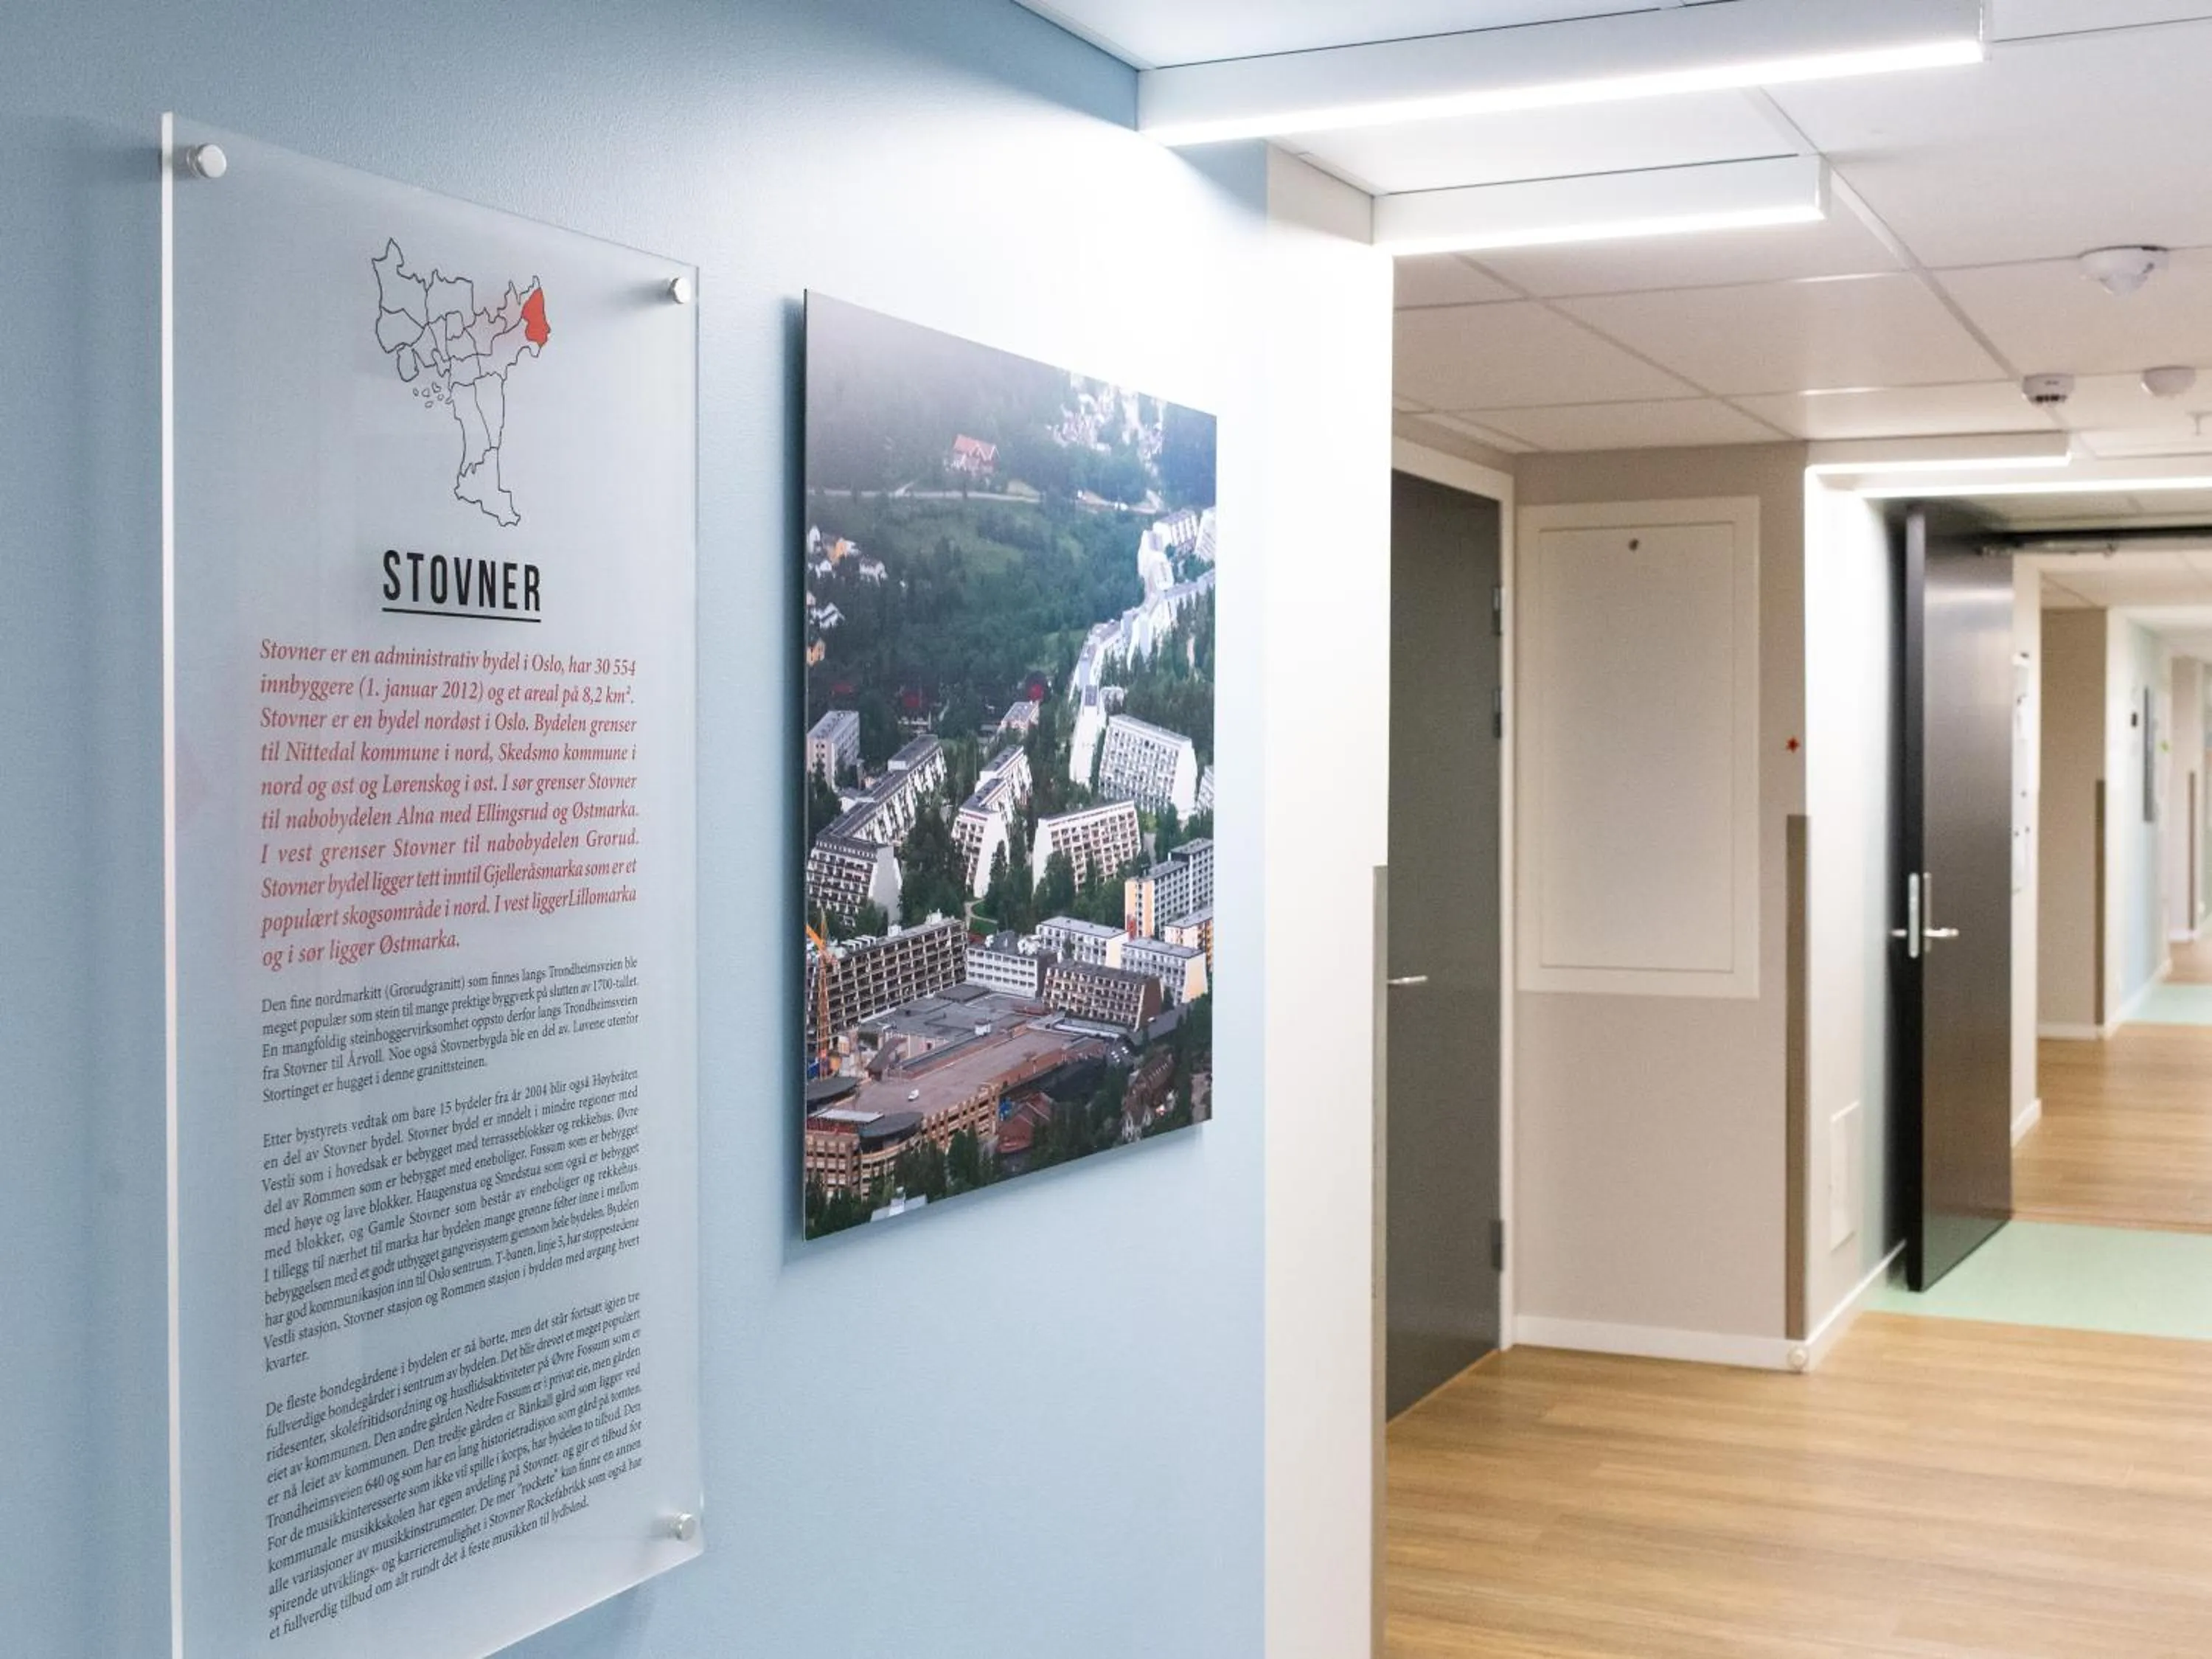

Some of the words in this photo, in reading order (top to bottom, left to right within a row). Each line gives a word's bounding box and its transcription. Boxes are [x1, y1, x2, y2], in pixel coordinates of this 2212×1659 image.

[382, 549, 541, 612] STOVNER
[259, 638, 326, 661] Stovner
[330, 648, 347, 662] er
[349, 649, 370, 664] en
[373, 644, 479, 669] administrativ
[481, 649, 521, 675] bydel
[530, 653, 564, 675] Oslo,
[568, 654, 592, 673] har
[260, 672, 354, 702] innbyggere
[383, 677, 438, 703] januar
[440, 679, 484, 703] 2012)
[487, 686, 505, 706] og
[507, 684, 521, 700] et
[524, 683, 560, 702] areal
[560, 684, 579, 708] på
[581, 685, 602, 706] 8,2
[259, 706, 327, 728] Stovner
[330, 714, 349, 728] er
[352, 714, 372, 729] en
[377, 708, 420, 735] bydel
[423, 709, 481, 731] nordøst
[494, 711, 529, 731] Oslo.
[532, 712, 586, 737] Bydelen
[588, 719, 636, 738] grenser
[260, 740, 280, 761] til
[284, 740, 356, 762] Nittedal
[360, 740, 439, 762] kommune
[454, 740, 493, 765] nord,
[497, 741, 560, 762] Skedsmo
[562, 742, 628, 761] kommune
[260, 773, 303, 796] nord
[306, 780, 327, 801] og
[330, 776, 355, 795] øst
[358, 779, 378, 800] og
[381, 772, 461, 799] Lørenskog
[472, 774, 497, 792] øst.
[510, 777, 533, 791] sør
[534, 776, 585, 796] grenser
[587, 771, 637, 790] Stovner
[261, 807, 280, 830] til
[285, 804, 392, 834] nabobydelen
[396, 804, 434, 825] Alna
[439, 802, 472, 824] med
[475, 801, 549, 827] Ellingsrud
[552, 804, 569, 826] og
[571, 798, 639, 820] Østmarka.
[278, 844, 313, 863] vest
[319, 844, 386, 868] grenser
[392, 837, 456, 858] Stovner
[462, 832, 480, 854] til
[486, 829, 579, 857] nabobydelen
[585, 827, 640, 847] Grorud.
[260, 877, 325, 899] Stovner
[327, 870, 370, 900] bydel
[371, 870, 414, 897] ligger
[415, 869, 440, 888] tett
[442, 863, 482, 886] inntil
[482, 858, 583, 888] Gjelleråsmarka
[584, 861, 610, 877] som
[611, 861, 624, 875] er
[625, 858, 637, 874] et
[260, 907, 339, 939] populært
[341, 897, 442, 930] skogsområde
[453, 894, 490, 917] nord.
[504, 894, 529, 912] vest
[531, 890, 568, 915] ligger
[262, 950, 283, 972] og
[297, 945, 325, 963] sør
[329, 938, 375, 965] ligger
[378, 928, 459, 955] Østmarka.
[261, 998, 287, 1013] Den
[289, 993, 312, 1009] fine
[467, 976, 488, 988] som
[490, 970, 520, 986] finnes
[521, 967, 546, 984] langs
[262, 1018, 299, 1037] meget
[299, 1012, 347, 1034] populær
[349, 1010, 373, 1025] som
[374, 1004, 400, 1024] stein
[401, 1001, 414, 1018] til
[414, 1001, 449, 1017] mange
[262, 1064, 279, 1080] fra
[282, 1057, 327, 1078] Stovner
[330, 1053, 344, 1070] til
[262, 1082, 319, 1103] Stortinget
[321, 1081, 333, 1093] er
[335, 1072, 373, 1093] hugget
[381, 1067, 415, 1083] denne
[262, 1132, 292, 1148] Etter
[295, 1121, 347, 1144] bystyrets
[351, 1110, 388, 1130] vedtak
[391, 1111, 409, 1124] om
[411, 1105, 436, 1120] bare
[439, 1100, 452, 1116] 15
[262, 1158, 279, 1170] en
[282, 1148, 302, 1166] del
[304, 1149, 319, 1162] av
[322, 1139, 369, 1159] Stovner
[407, 1121, 449, 1142] Stovner
[451, 1114, 479, 1136] bydel
[264, 1239, 292, 1260] med
[348, 1225, 366, 1242] og
[365, 1211, 405, 1235] Gamle
[408, 1203, 450, 1227] Stovner
[454, 1200, 477, 1214] som
[265, 1401, 283, 1417] De
[286, 1391, 316, 1411] fleste
[319, 1366, 398, 1402] bondegårdene
[407, 1350, 448, 1374] bydelen
[266, 1492, 281, 1506] er
[282, 1482, 297, 1500] nå
[300, 1474, 325, 1495] leiet
[327, 1470, 341, 1484] av
[267, 1535, 338, 1573] kommunale
[341, 1506, 415, 1545] musikkskolen
[417, 1496, 436, 1515] har
[438, 1489, 462, 1509] egen
[465, 1472, 507, 1498] avdeling
[268, 1624, 280, 1640] et
[283, 1601, 338, 1635] fullverdig
[339, 1579, 372, 1610] tilbud
[374, 1579, 393, 1595] om
[394, 1570, 408, 1587] alt
[410, 1556, 439, 1581] rundt
